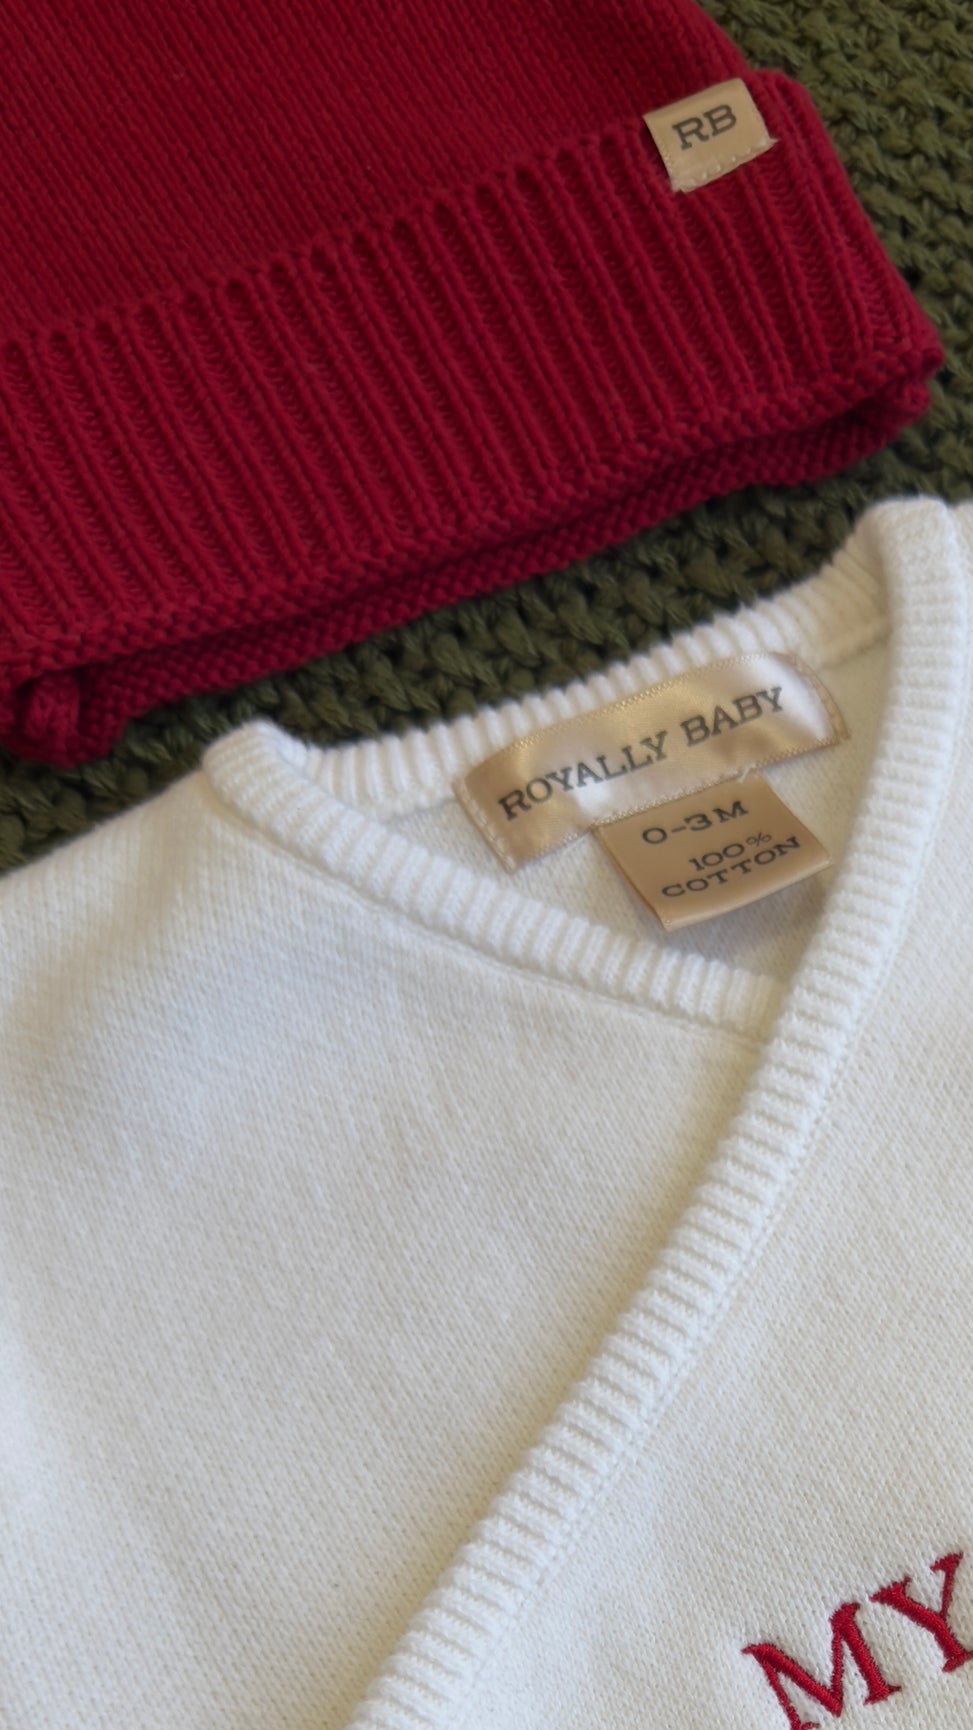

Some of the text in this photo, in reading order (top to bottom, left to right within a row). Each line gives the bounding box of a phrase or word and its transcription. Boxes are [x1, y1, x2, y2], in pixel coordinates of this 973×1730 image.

[672, 104, 737, 150] RB
[498, 687, 783, 820] ROYALLY BABY
[661, 836, 800, 897] COTTON
[688, 832, 772, 871] 100%
